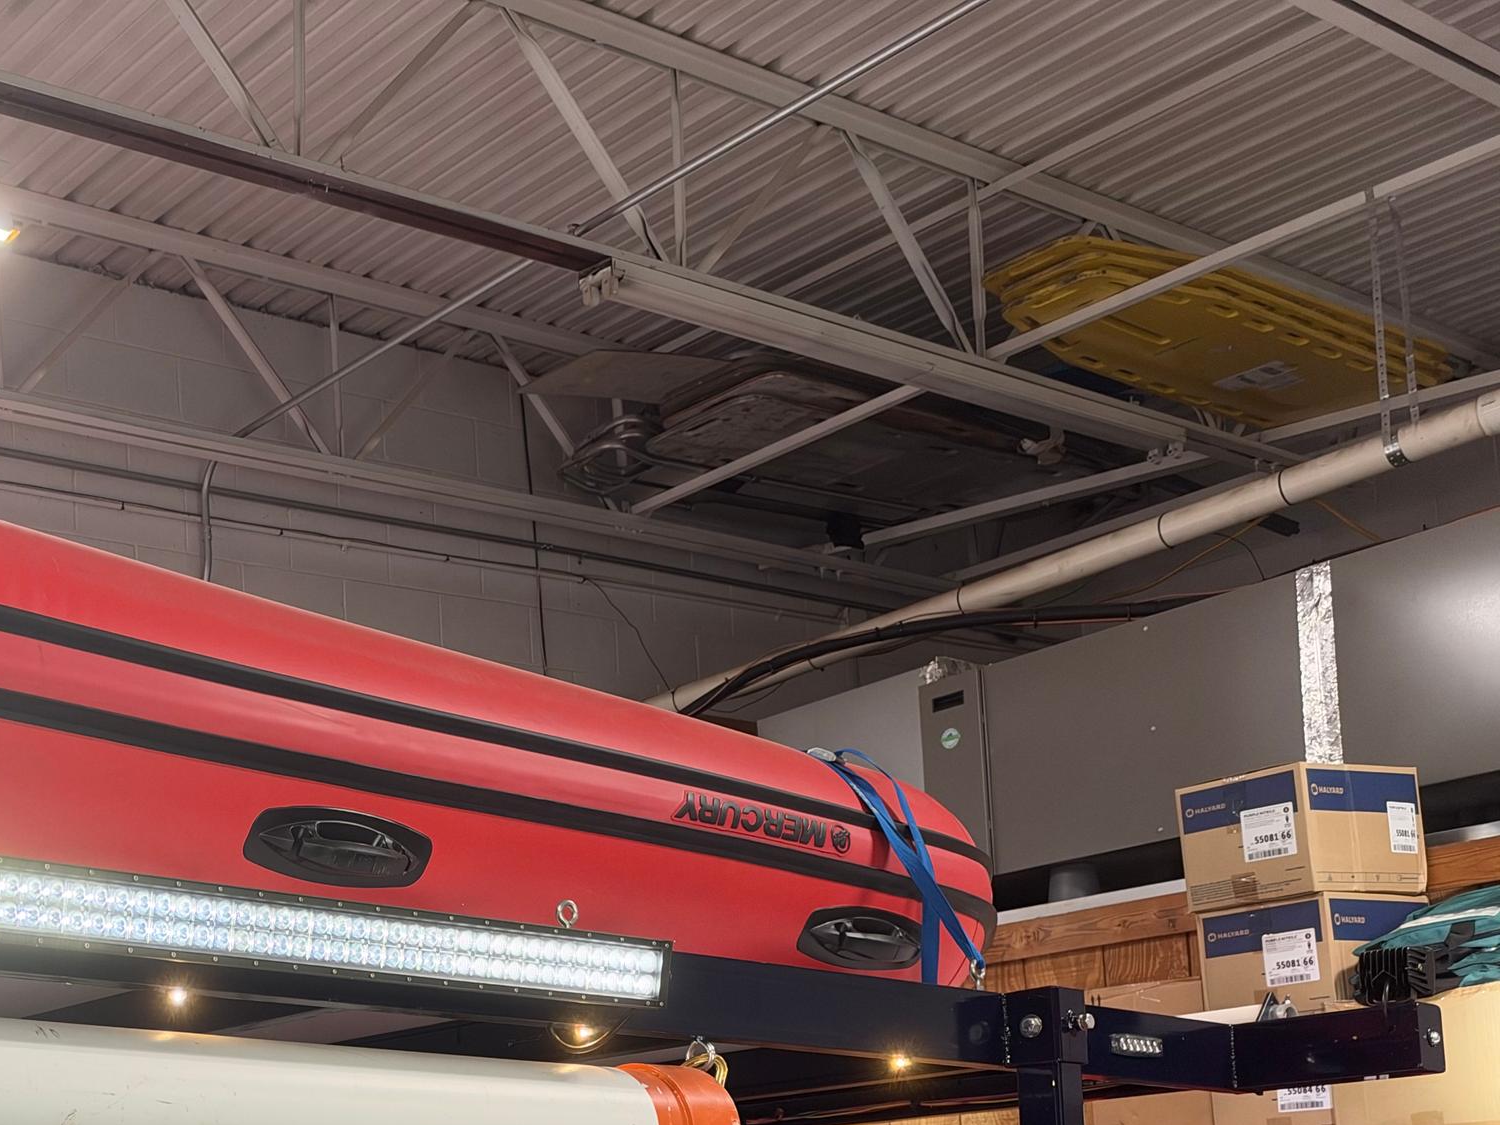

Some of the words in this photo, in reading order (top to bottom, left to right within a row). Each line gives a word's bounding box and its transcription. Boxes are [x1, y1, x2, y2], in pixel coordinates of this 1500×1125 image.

[1194, 803, 1226, 815] HALYARD
[675, 790, 827, 848] MERCURY
[1217, 928, 1250, 940] HALYARD
